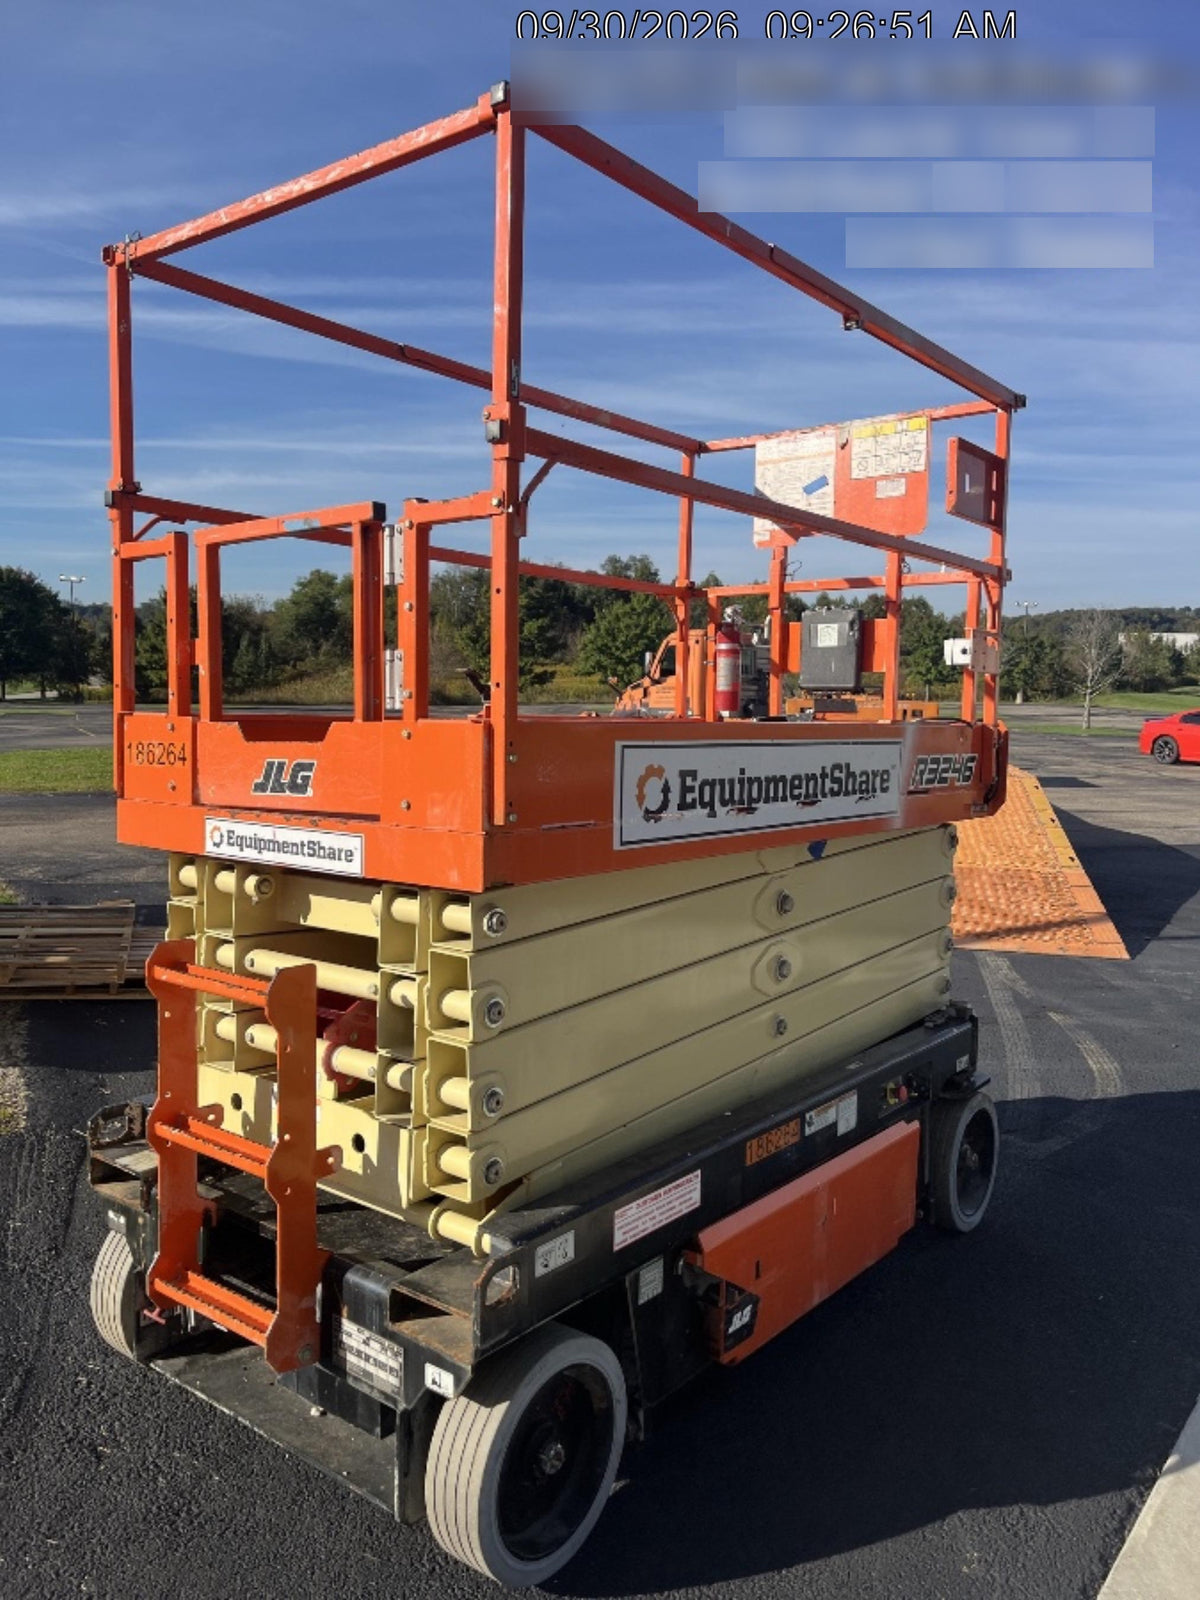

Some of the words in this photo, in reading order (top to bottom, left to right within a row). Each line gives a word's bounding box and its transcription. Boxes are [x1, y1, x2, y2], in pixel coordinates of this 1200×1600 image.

[127, 742, 187, 766] 186264
[910, 754, 978, 790] R3246
[250, 758, 316, 797] JLG
[677, 762, 891, 818] EquipmentShare
[226, 829, 355, 863] EquipmentShare
